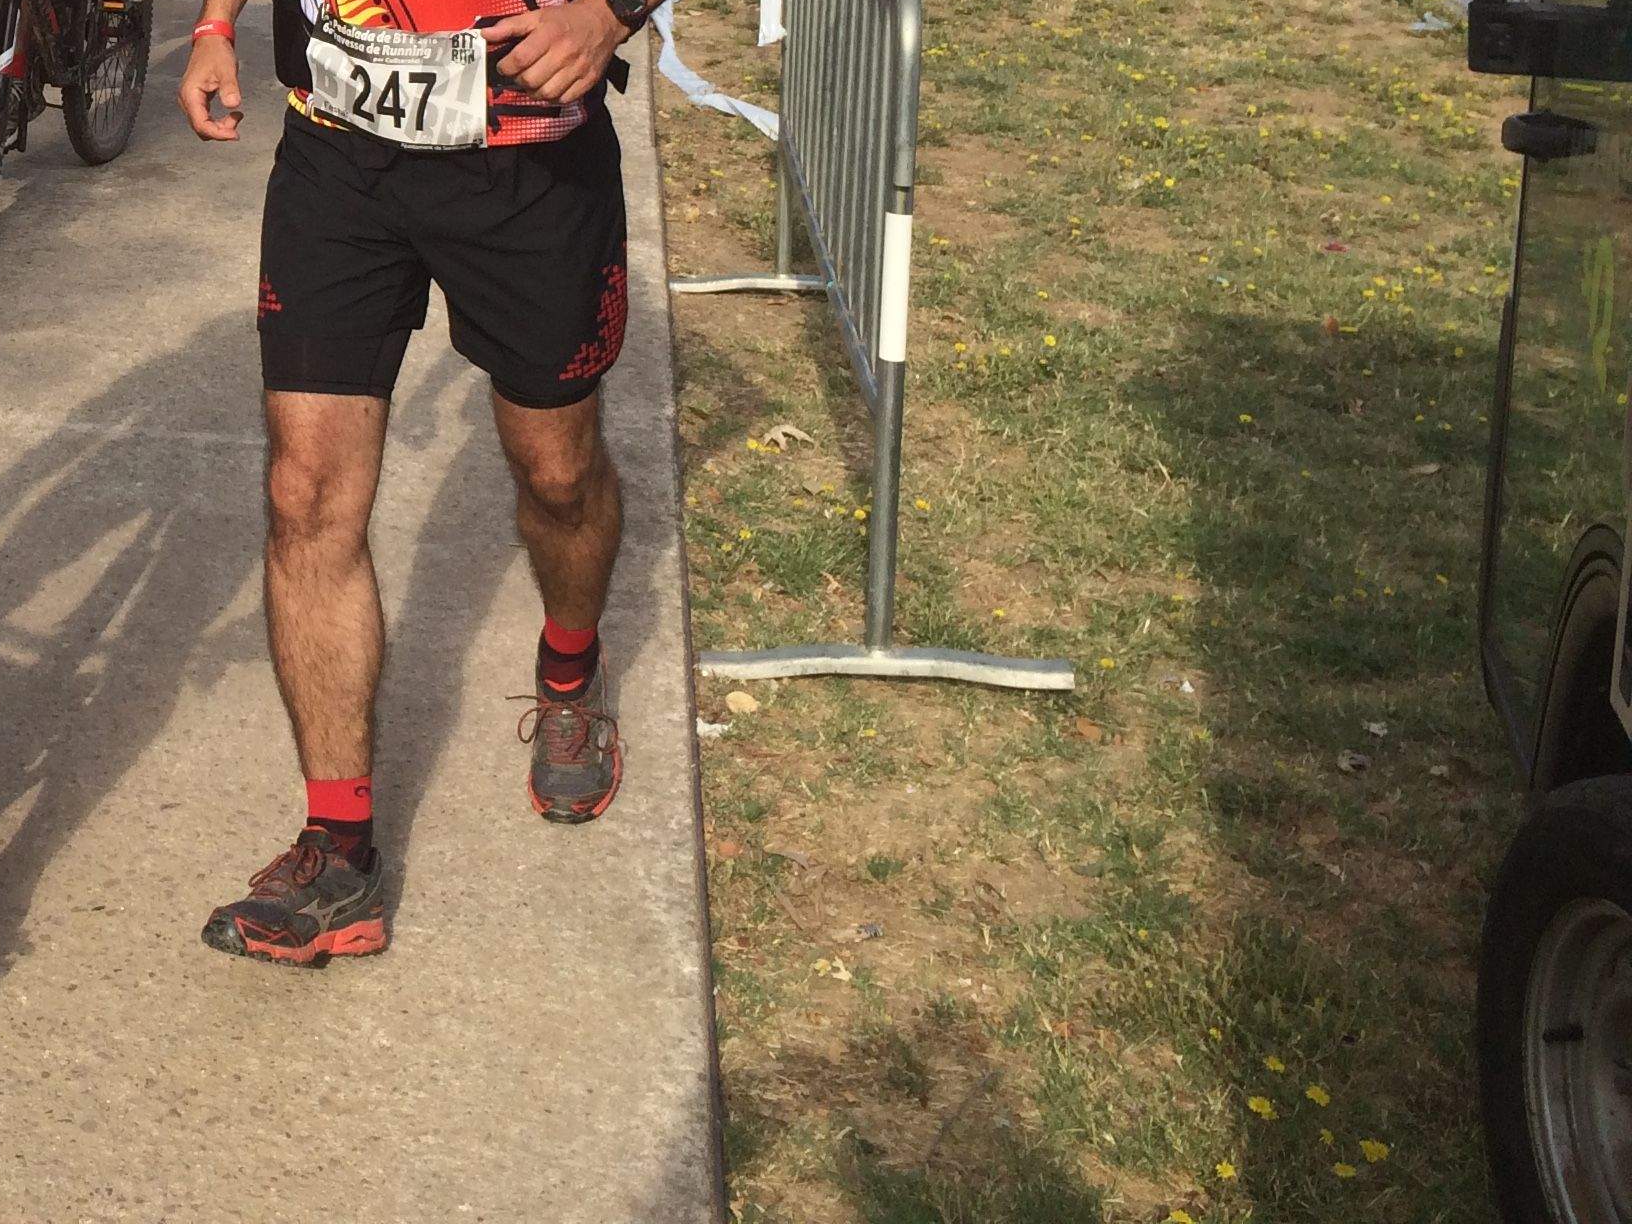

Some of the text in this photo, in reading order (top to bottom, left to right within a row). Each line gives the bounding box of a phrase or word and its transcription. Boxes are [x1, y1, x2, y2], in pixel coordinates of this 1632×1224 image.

[366, 44, 380, 56] de
[382, 44, 432, 59] Running
[350, 64, 438, 132] 247
